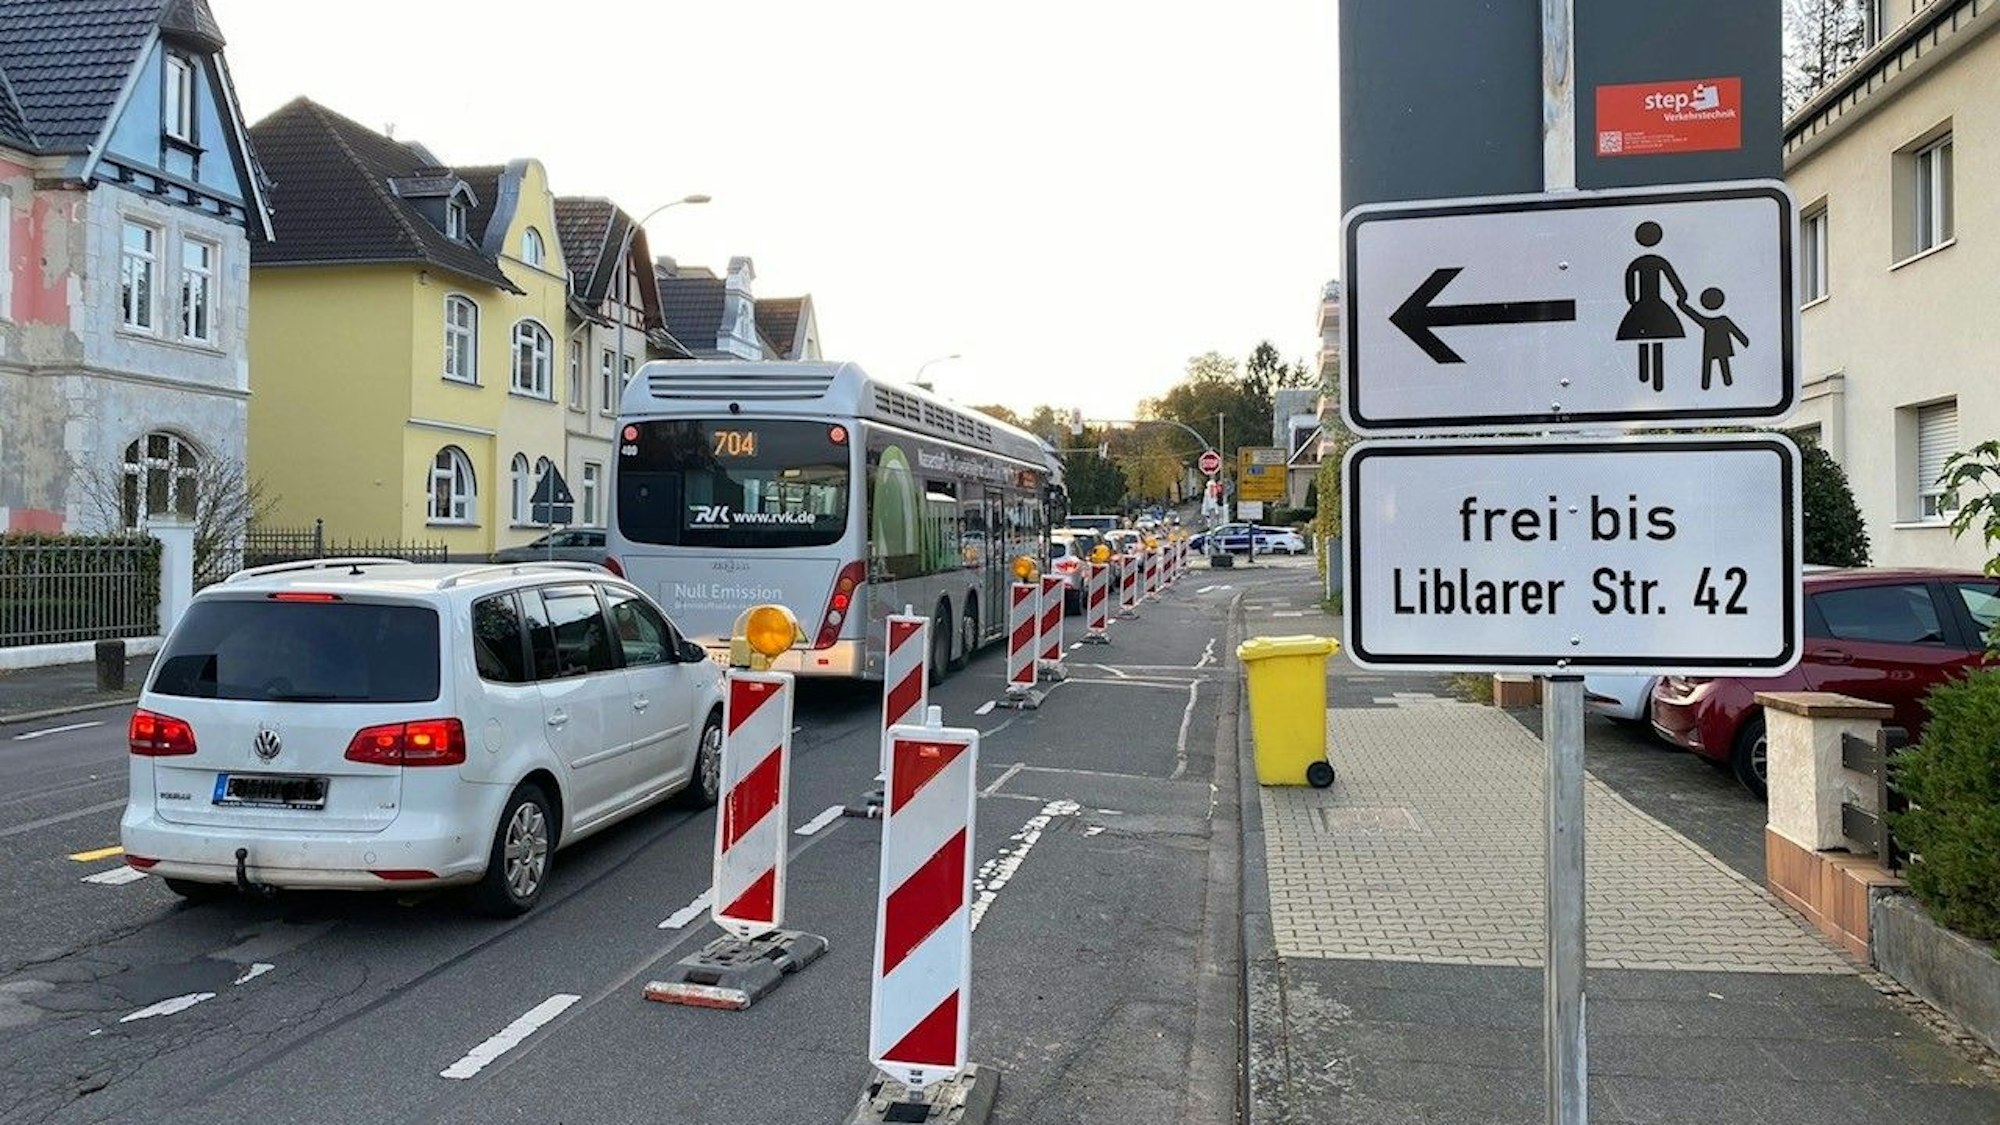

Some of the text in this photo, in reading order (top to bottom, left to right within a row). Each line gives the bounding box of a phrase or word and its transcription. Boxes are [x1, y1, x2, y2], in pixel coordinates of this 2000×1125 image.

[1644, 91, 1689, 112] step
[1663, 108, 1737, 122] Verkehrstechnik
[714, 430, 755, 456] 704
[733, 511, 816, 524] www.rvk.de
[1459, 494, 1677, 542] frei bis
[674, 583, 782, 600] Null Emission
[1393, 566, 1749, 615] Liblarer Str. 42
